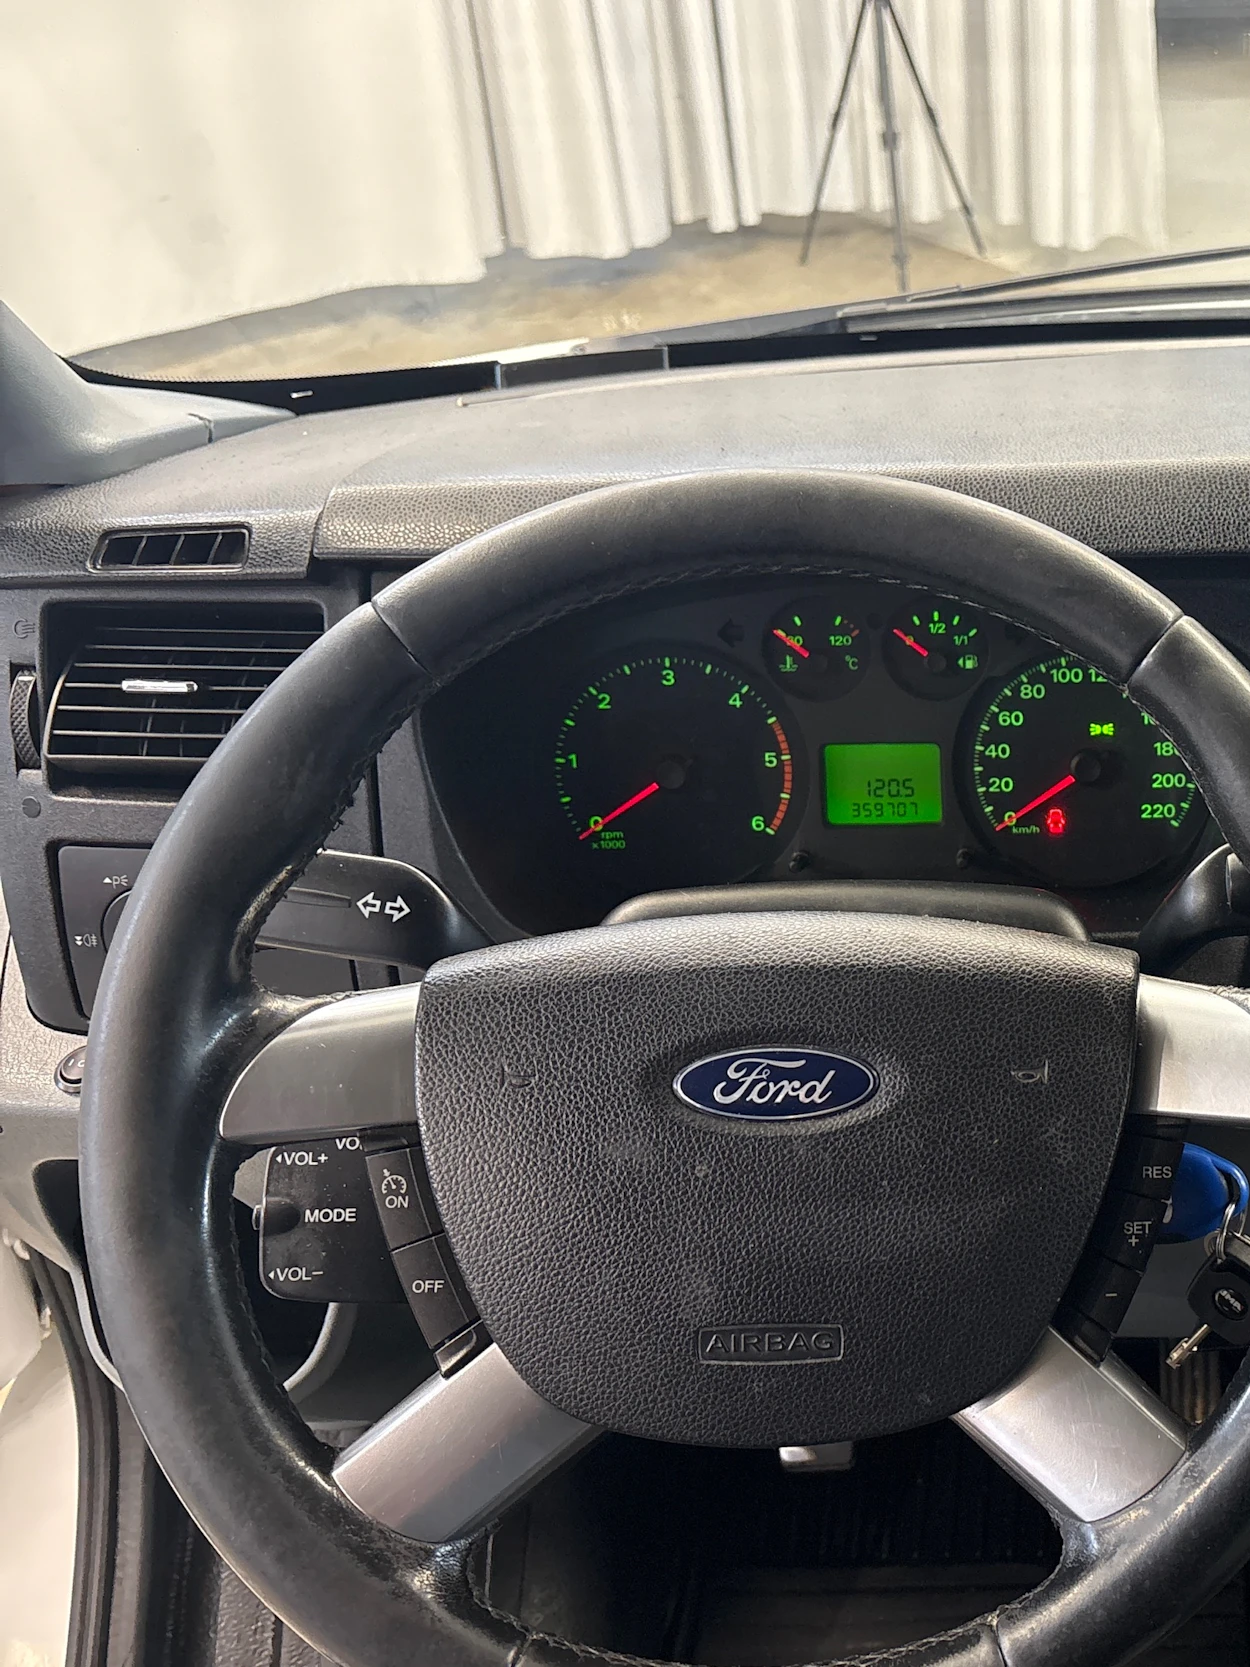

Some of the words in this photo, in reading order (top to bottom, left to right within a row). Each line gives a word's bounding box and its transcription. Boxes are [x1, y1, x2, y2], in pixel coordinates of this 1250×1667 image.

[929, 623, 946, 634] 1/2
[829, 635, 852, 646] 120
[953, 635, 968, 645] 1/1
[662, 670, 675, 686] 3
[1050, 668, 1083, 683] 100
[1020, 684, 1045, 699] 80
[598, 694, 611, 709] 2
[729, 693, 743, 708] 4
[998, 712, 1024, 726] 60
[985, 744, 1010, 759] 40
[1154, 741, 1180, 756] 18
[568, 753, 578, 768] 1
[765, 752, 777, 767] 5
[988, 778, 1014, 792] 20
[1152, 773, 1186, 788] 200
[852, 802, 918, 818] 359707
[1141, 804, 1176, 819] 220
[752, 815, 765, 831] 6
[1012, 825, 1040, 834] km/h
[601, 831, 624, 840] rpm
[713, 1057, 836, 1105] Ford
[335, 1137, 363, 1150] VO
[283, 1151, 329, 1166] VOL+
[1142, 1166, 1172, 1179] RES
[385, 1196, 409, 1209] ON
[304, 1208, 357, 1223] MODE
[1123, 1221, 1152, 1235] SET
[412, 1280, 445, 1293] OFF
[706, 1331, 834, 1353] AIRBAG
